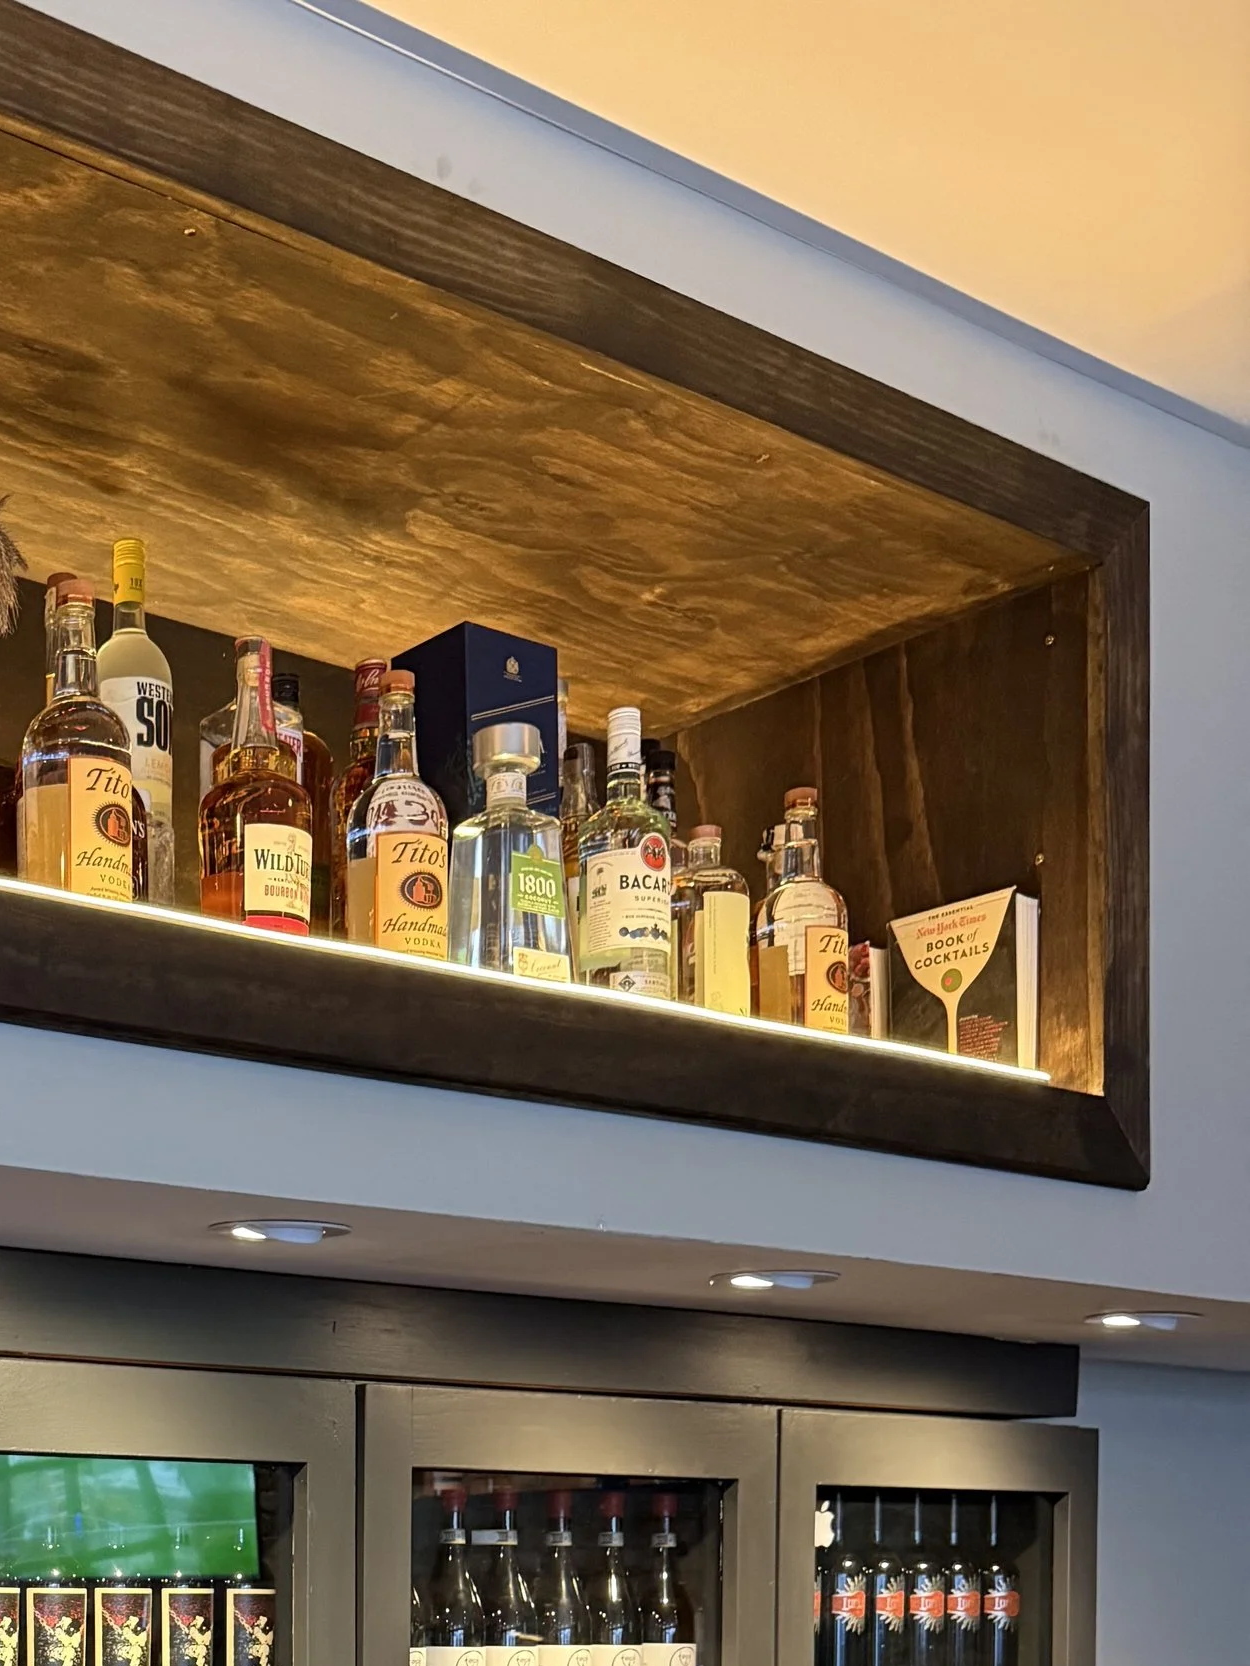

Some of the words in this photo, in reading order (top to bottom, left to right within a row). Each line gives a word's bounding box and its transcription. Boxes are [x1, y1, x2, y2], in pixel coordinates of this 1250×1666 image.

[254, 848, 293, 872] WILD
[392, 838, 447, 868] Tito's
[518, 873, 556, 898] 1800
[928, 913, 940, 921] THE
[941, 905, 974, 918] ESSENTIAL
[916, 926, 936, 941] New
[936, 919, 958, 936] York
[958, 913, 987, 927] Times
[404, 936, 441, 950] VODKA
[926, 933, 965, 953] BOOK
[966, 928, 979, 943] of
[914, 942, 990, 970] COCKTAILS
